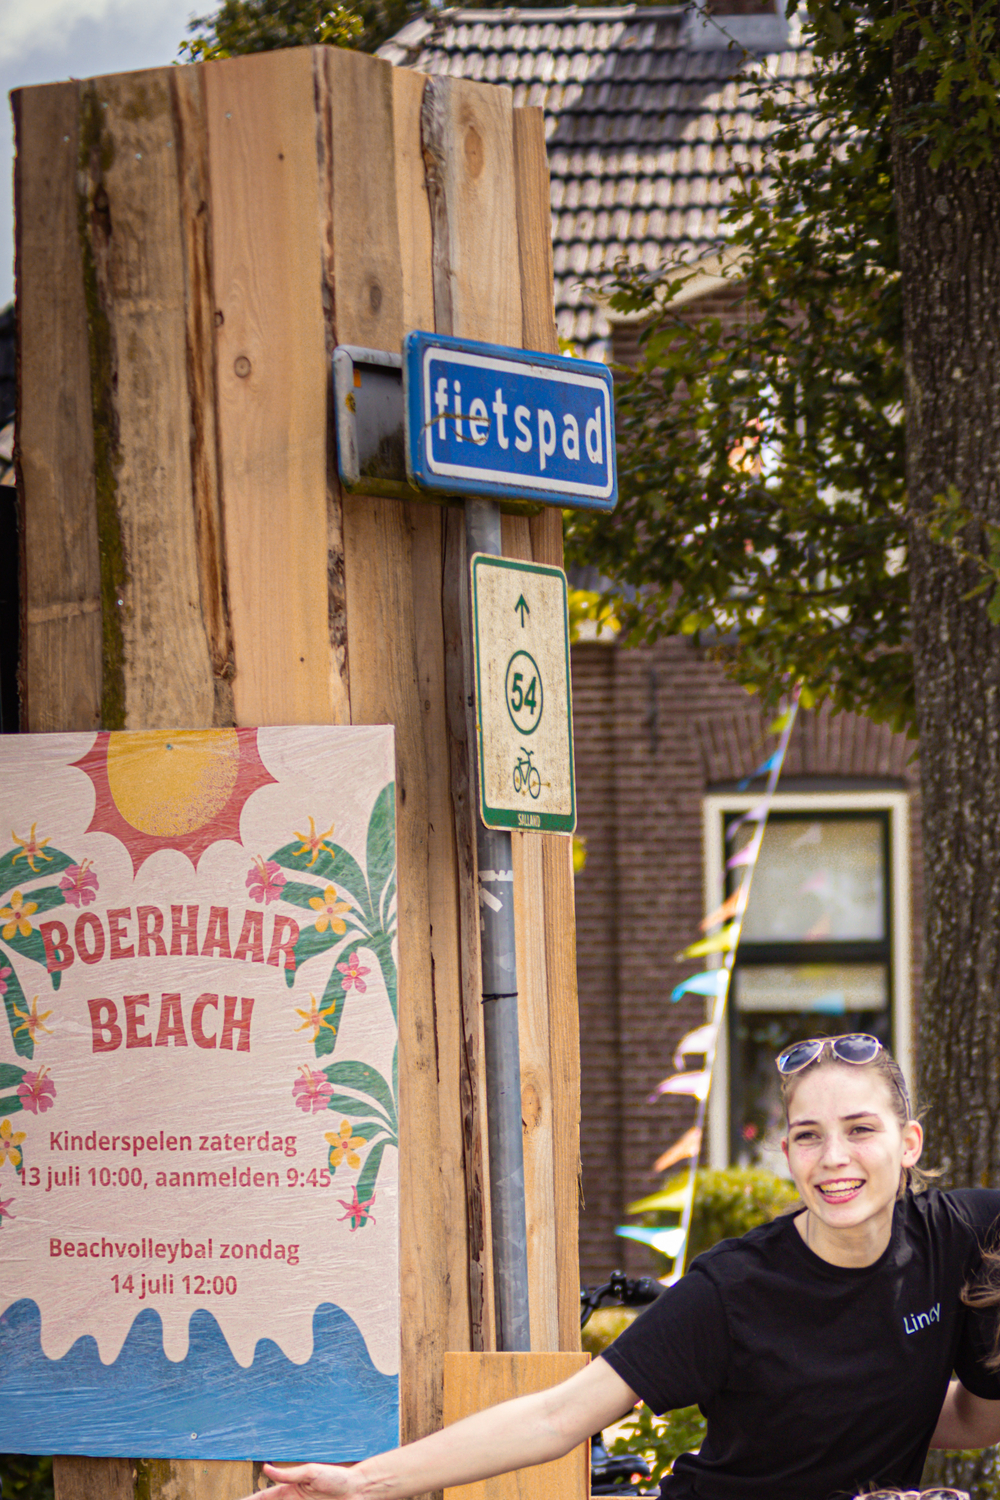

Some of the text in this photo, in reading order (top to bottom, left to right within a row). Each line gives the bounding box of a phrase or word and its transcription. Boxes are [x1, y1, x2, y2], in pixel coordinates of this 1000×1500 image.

[435, 377, 603, 471] fietspad
[511, 672, 537, 715] 54
[39, 904, 300, 974] BOERHAAR
[87, 992, 255, 1053] BEACH
[50, 1130, 297, 1157] Kinderspelen zaterdag
[17, 1166, 332, 1192] 13 juli 10:00, aanmelden 9:45
[49, 1237, 300, 1266] Beachvolleybal zondag
[110, 1273, 238, 1300] 14 juli 12:00
